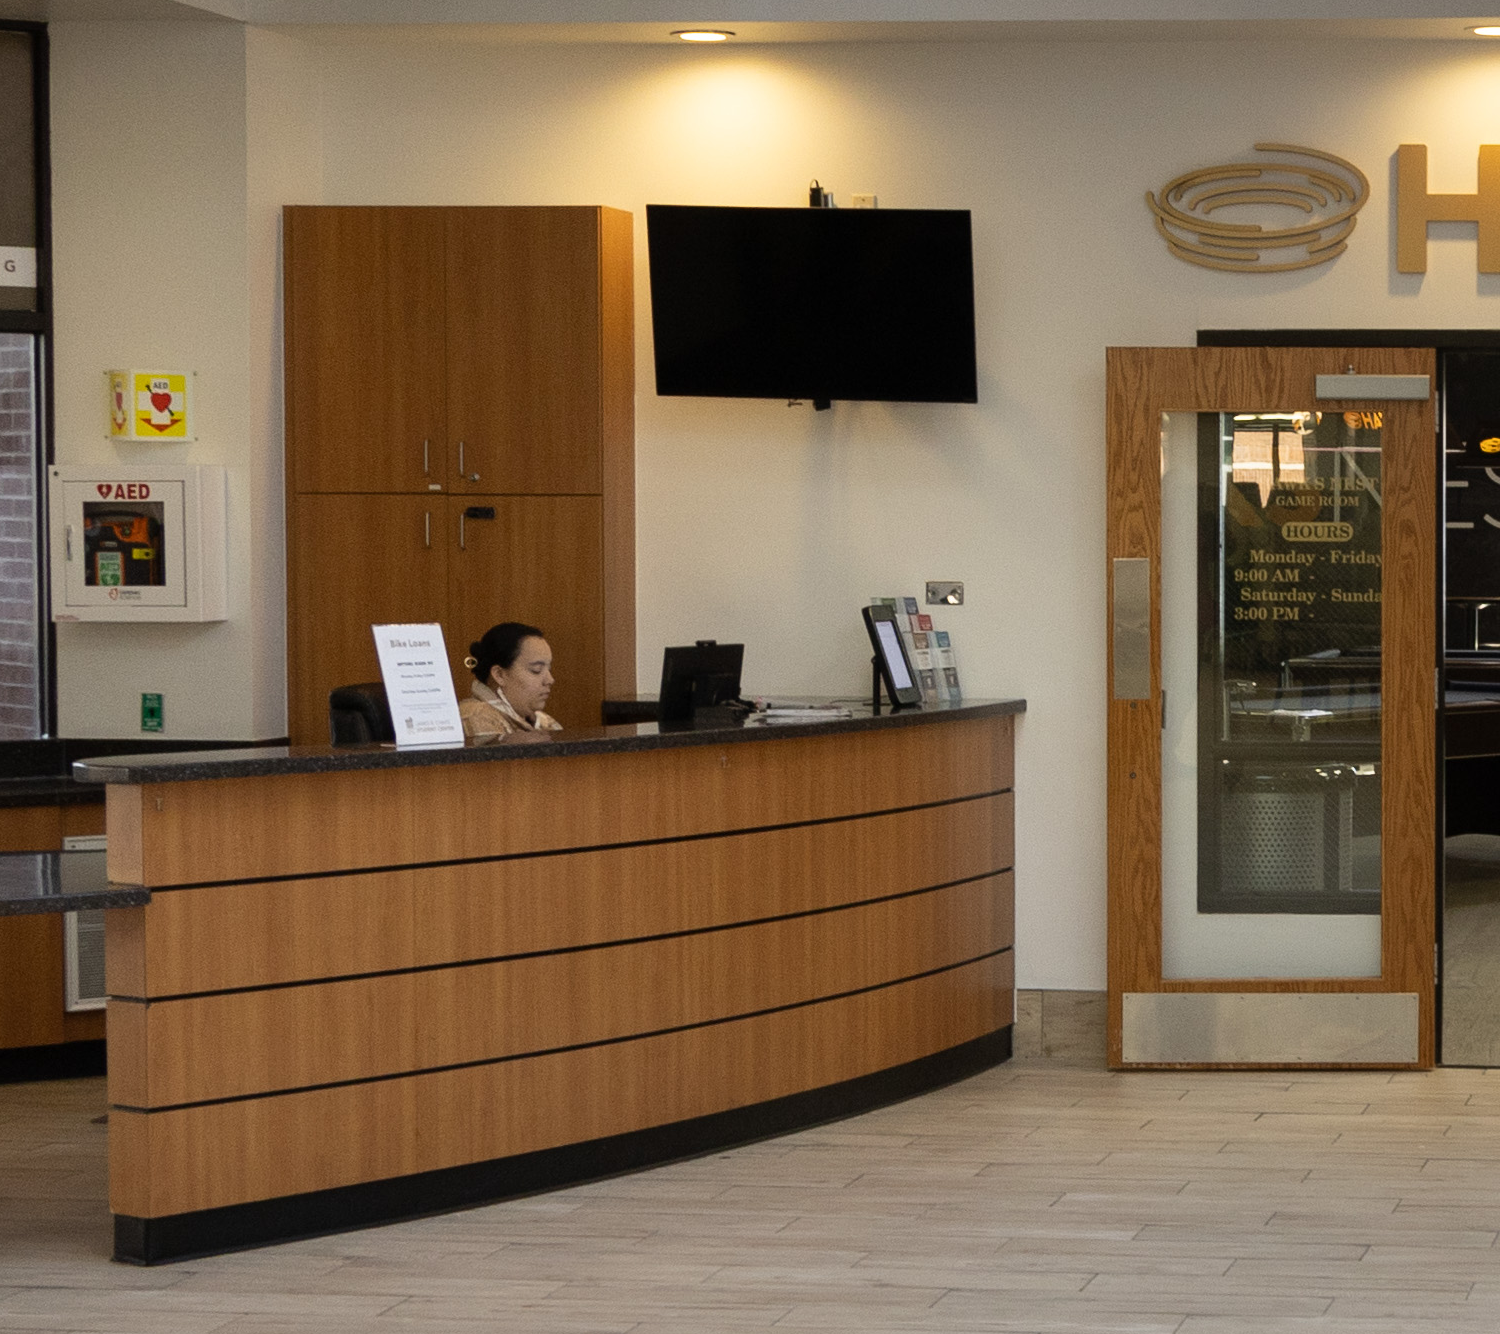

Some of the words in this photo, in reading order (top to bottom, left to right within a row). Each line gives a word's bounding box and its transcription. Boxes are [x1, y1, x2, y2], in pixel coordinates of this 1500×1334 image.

[153, 381, 169, 390] AED
[114, 483, 151, 500] AED
[1275, 495, 1316, 507] GAME
[1319, 495, 1360, 507] ROOM
[1286, 524, 1350, 539] HOURS
[1249, 549, 1316, 567] Monday
[1234, 569, 1268, 583] 9:00
[1272, 569, 1300, 583] AM
[1240, 587, 1317, 605] Saturday
[1234, 607, 1268, 621] 3:00
[1272, 607, 1300, 621] PM
[389, 639, 407, 648] Bike
[408, 639, 431, 648] Loans
